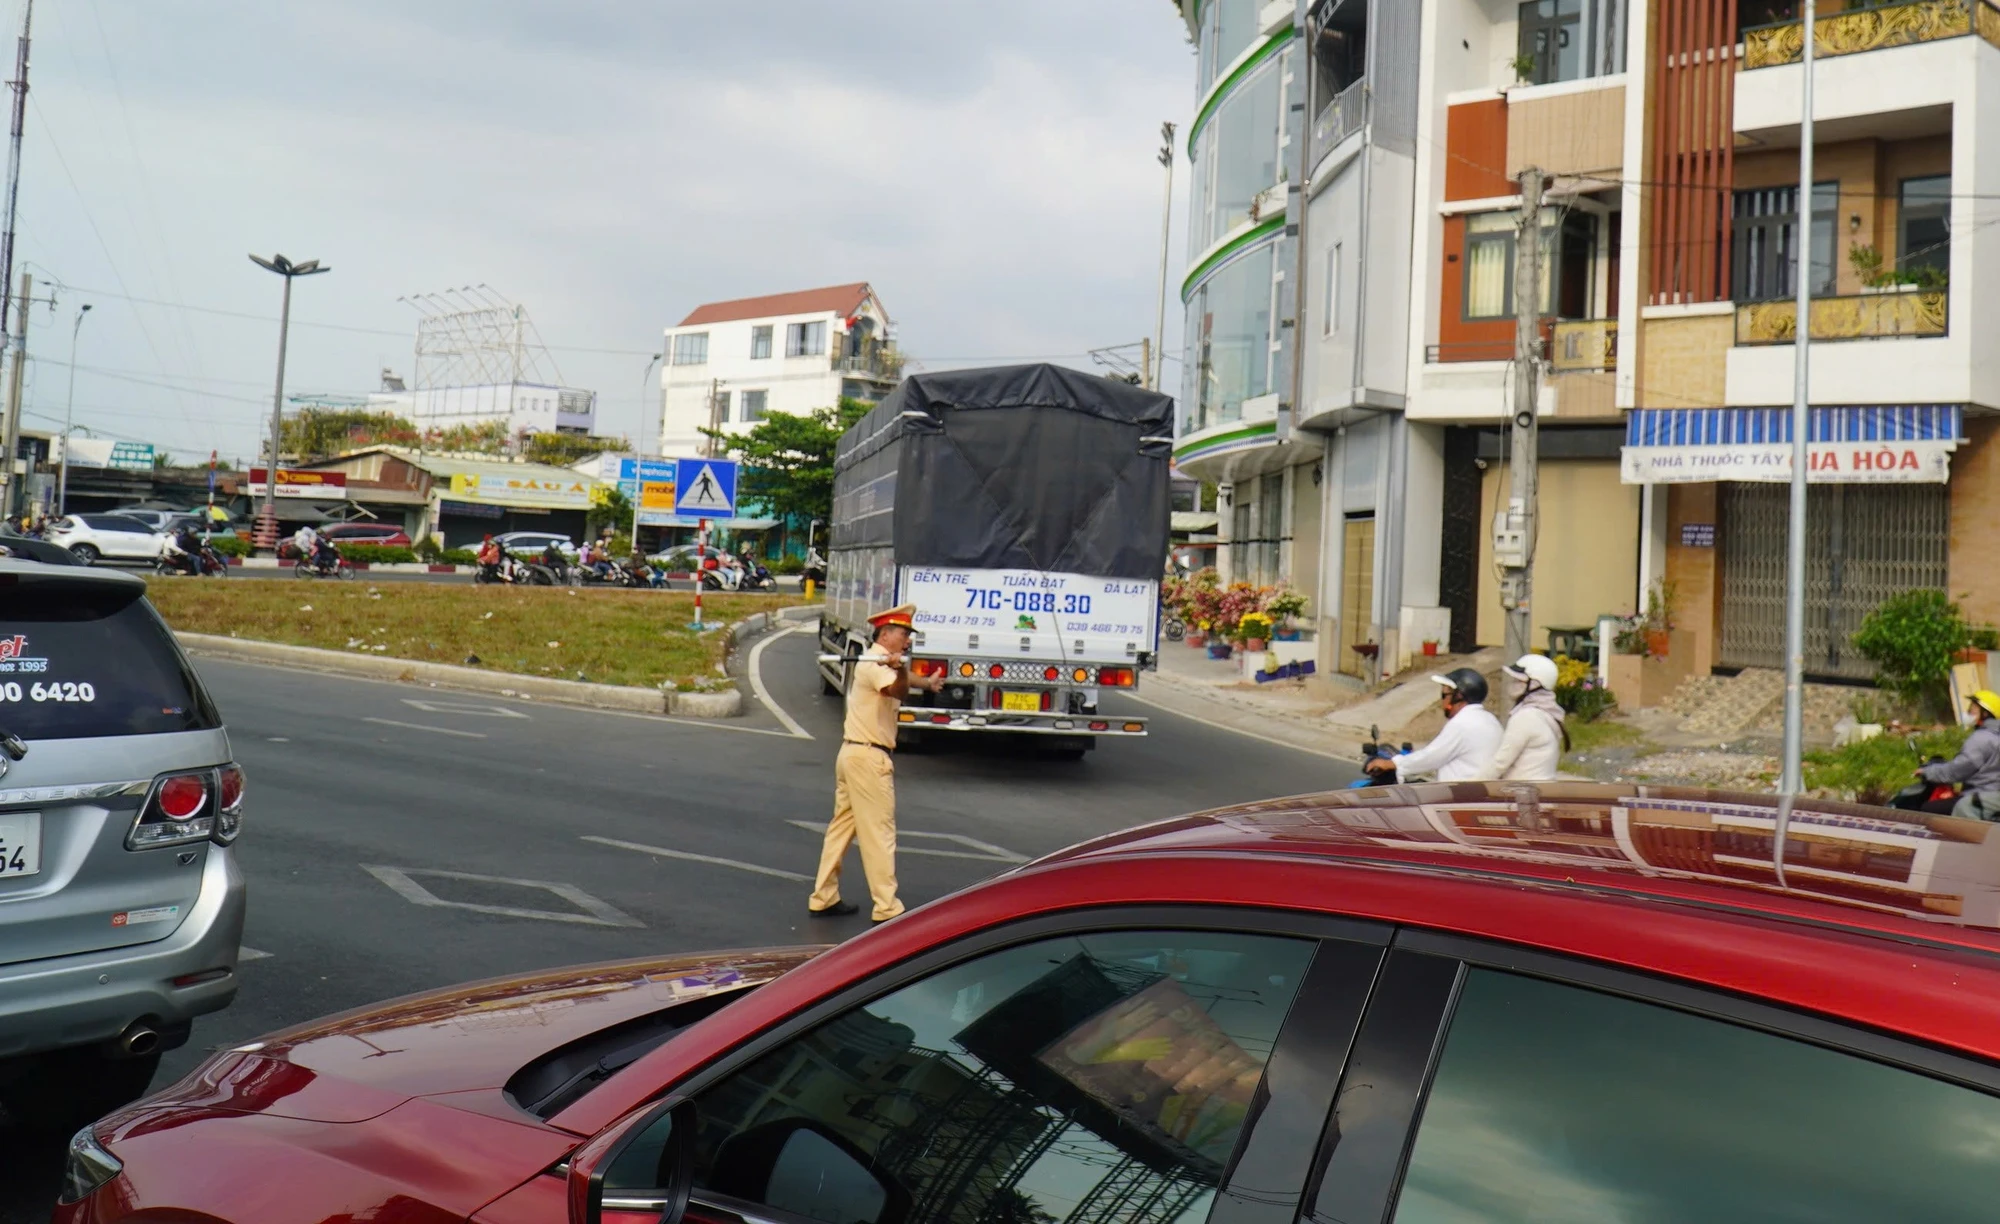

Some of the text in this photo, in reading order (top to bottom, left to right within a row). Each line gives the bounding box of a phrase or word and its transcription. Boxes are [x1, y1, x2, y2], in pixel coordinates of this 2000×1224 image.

[1651, 455, 1683, 467] NHÀ
[1789, 451, 1839, 471] IA
[1853, 445, 1920, 470] HÒA
[913, 567, 970, 585] BẾN TRE
[1003, 571, 1037, 587] TUẤN
[965, 588, 1091, 614] 71C-088.30
[915, 613, 946, 624] 0943
[949, 615, 960, 625] 41
[982, 617, 996, 627] 75
[19, 661, 48, 672] 1995
[30, 681, 96, 702] 6420
